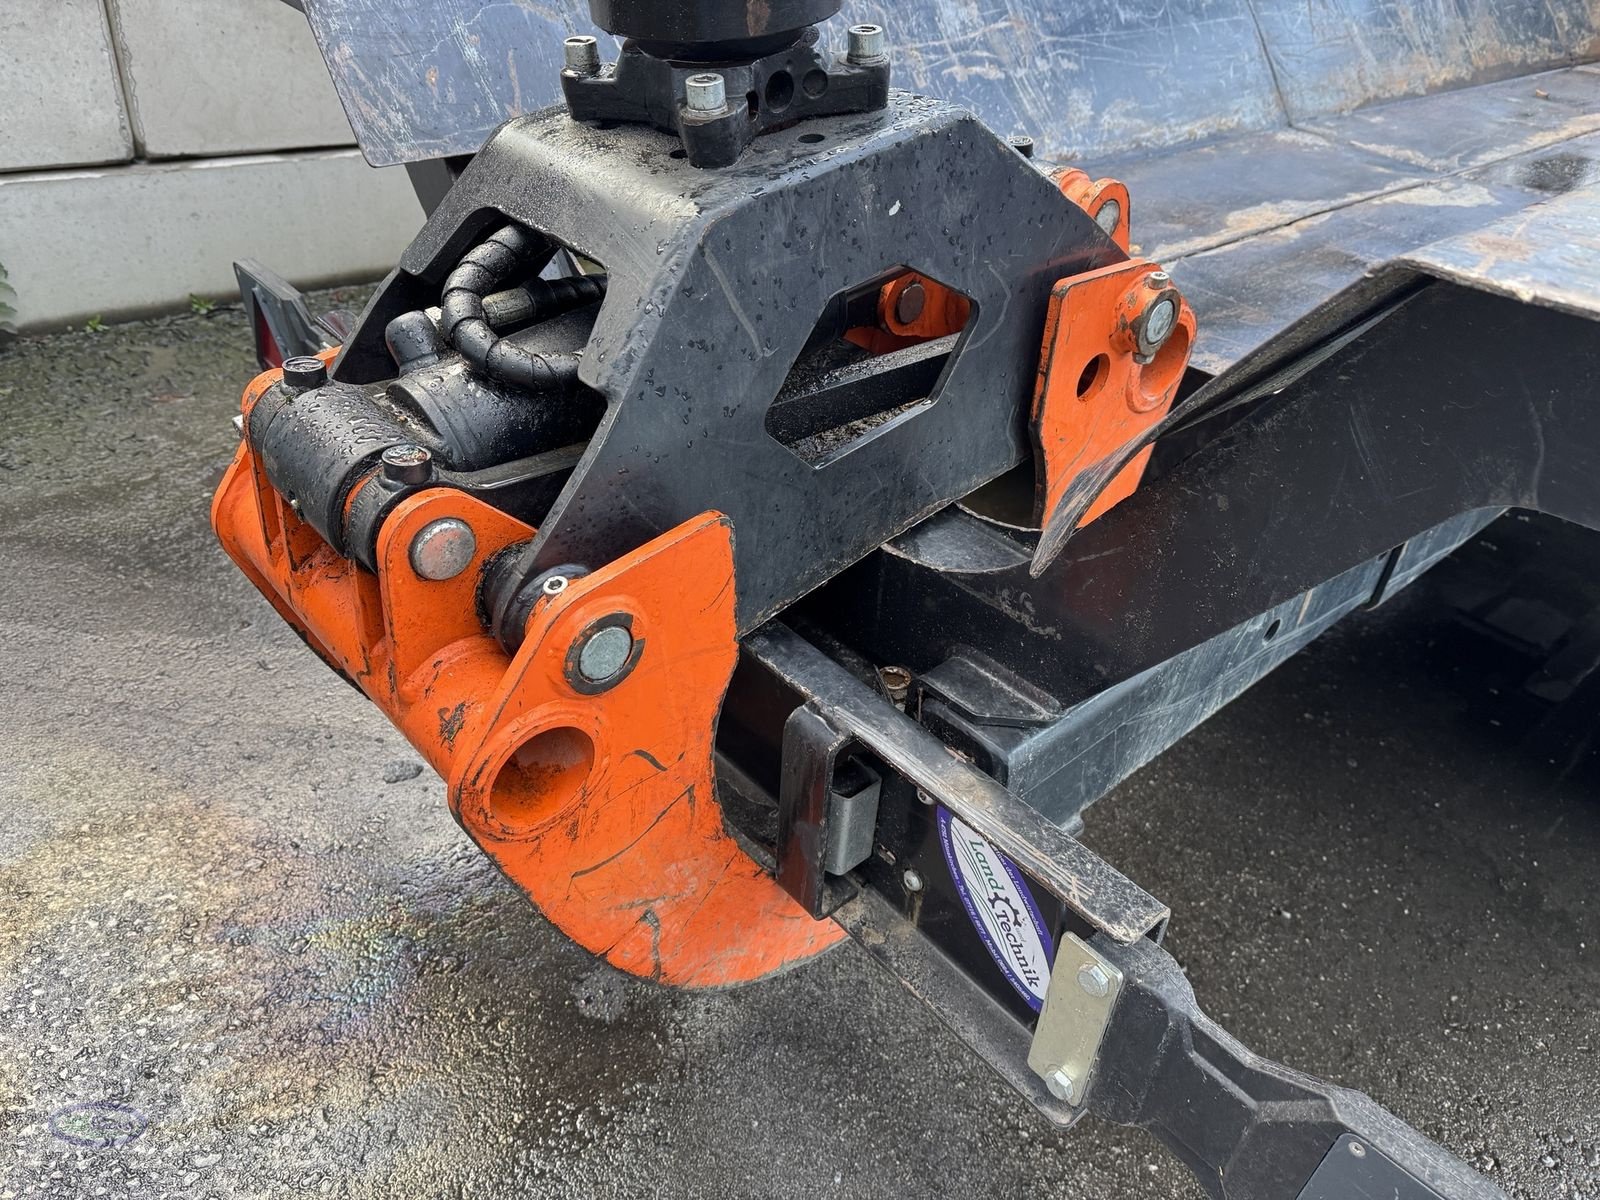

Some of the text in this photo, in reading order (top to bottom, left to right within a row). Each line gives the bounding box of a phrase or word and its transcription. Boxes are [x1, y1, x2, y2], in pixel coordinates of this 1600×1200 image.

[969, 839, 1005, 892] Land
[1006, 866, 1015, 879] der
[1014, 880, 1043, 936] Landwirtschaft
[985, 939, 1000, 959] Mobil
[995, 909, 1040, 988] Technik
